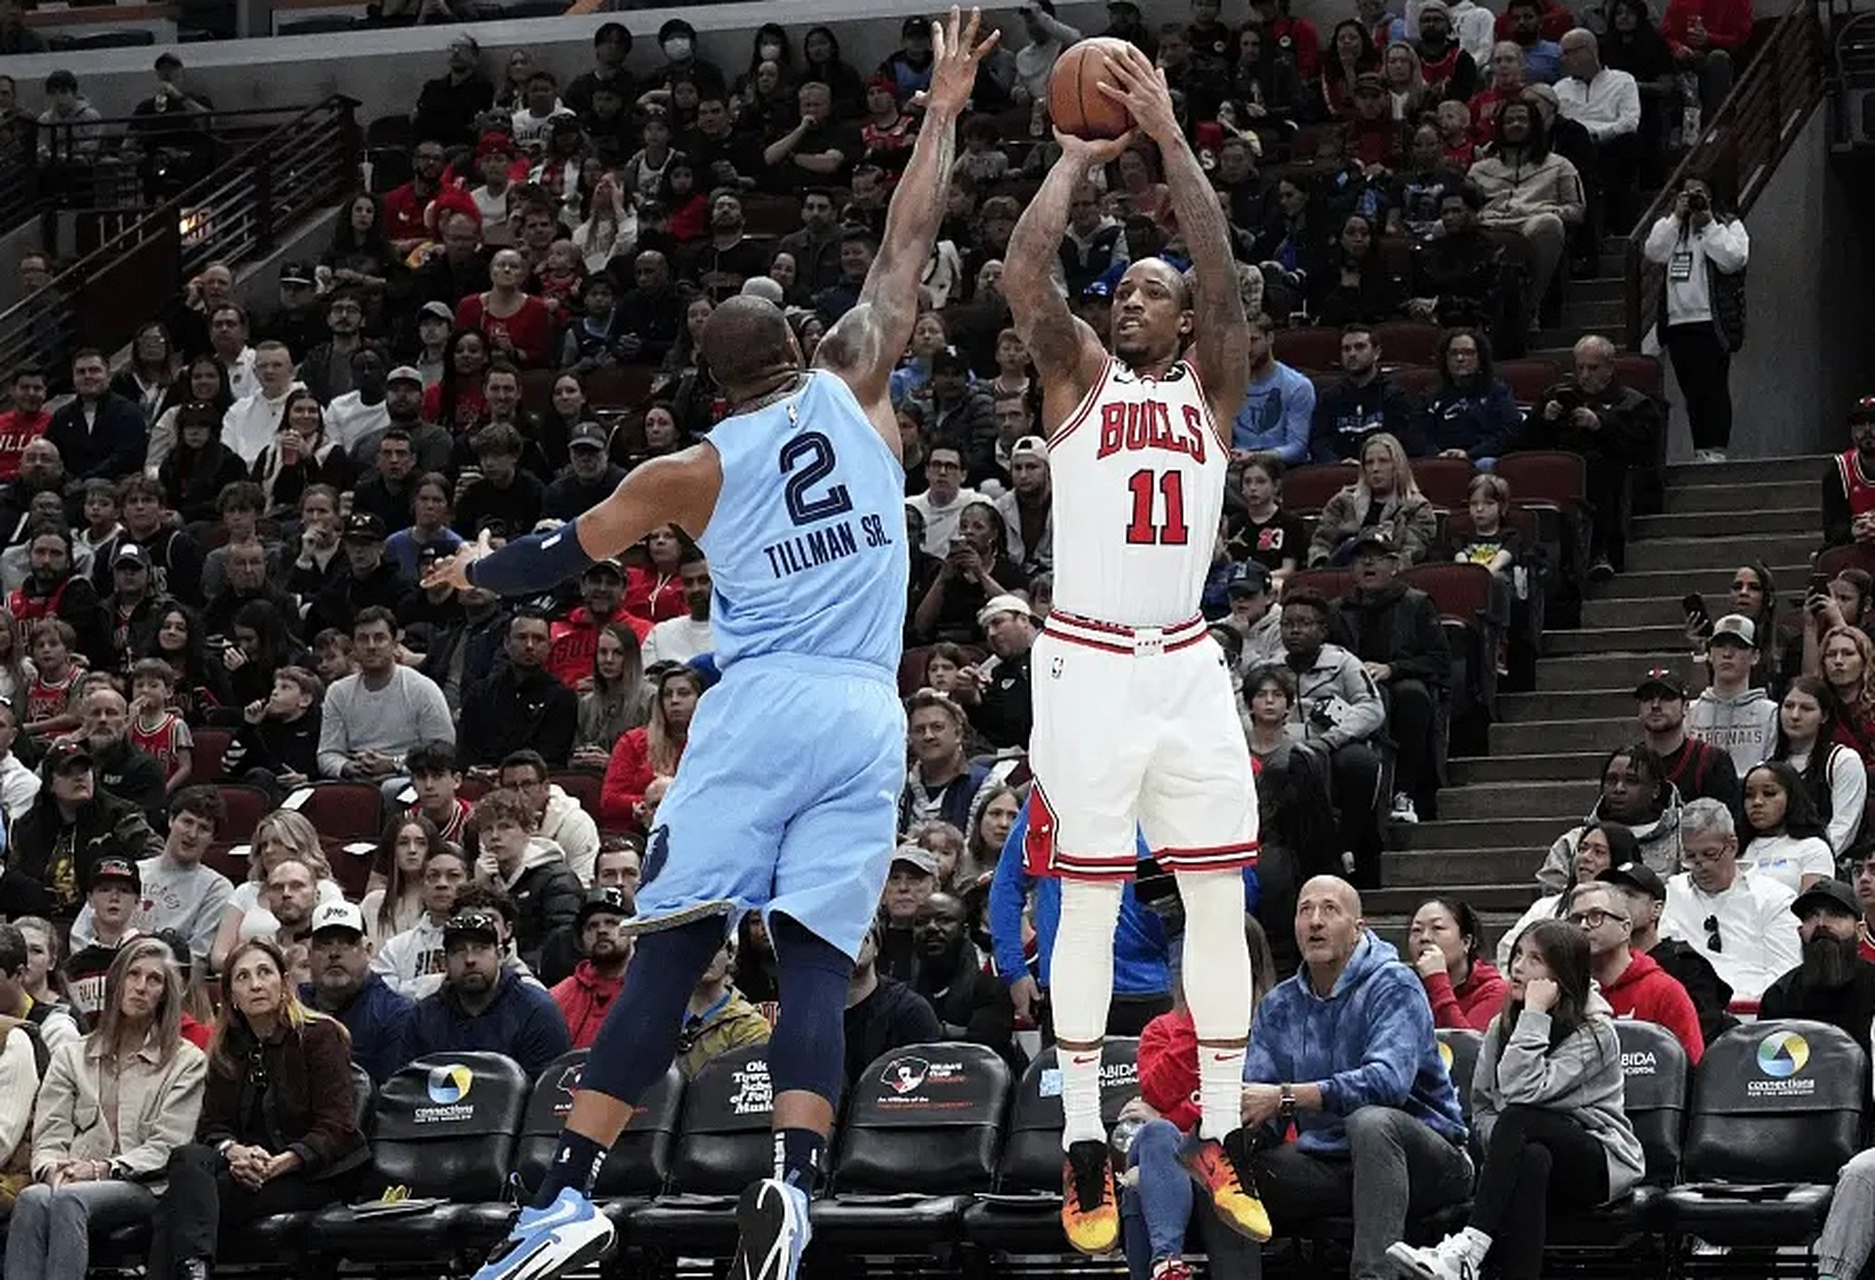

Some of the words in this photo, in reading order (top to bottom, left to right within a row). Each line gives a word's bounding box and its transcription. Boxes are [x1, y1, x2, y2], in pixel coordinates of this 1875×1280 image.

[1096, 399, 1207, 465] BULLS
[779, 431, 854, 527] 2
[1126, 468, 1188, 544] 11
[762, 520, 858, 579] TILLMAN
[860, 513, 893, 548] SR.
[1098, 1063, 1138, 1079] ABIDA
[1620, 1051, 1657, 1067] BIDA
